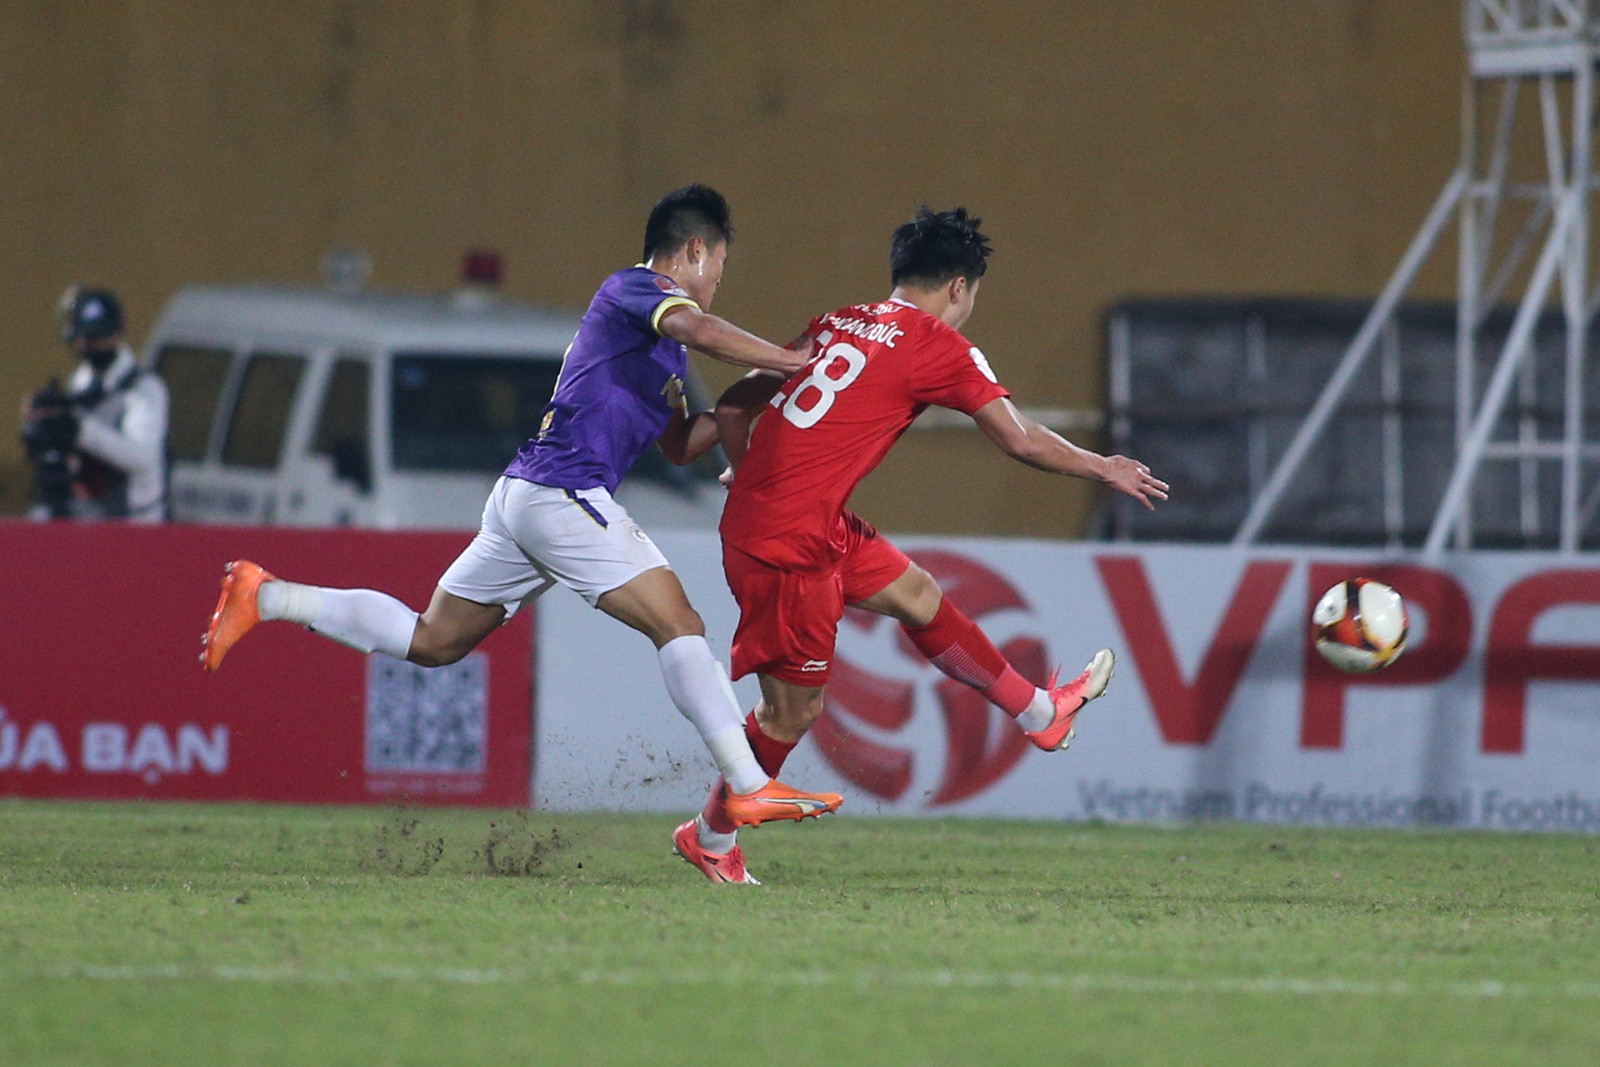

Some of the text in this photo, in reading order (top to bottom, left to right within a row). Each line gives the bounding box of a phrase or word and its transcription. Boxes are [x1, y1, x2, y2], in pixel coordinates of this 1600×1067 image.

[82, 722, 229, 784] BẠN
[1076, 777, 1236, 819] Vietnam
[1244, 780, 1470, 825] Professional
